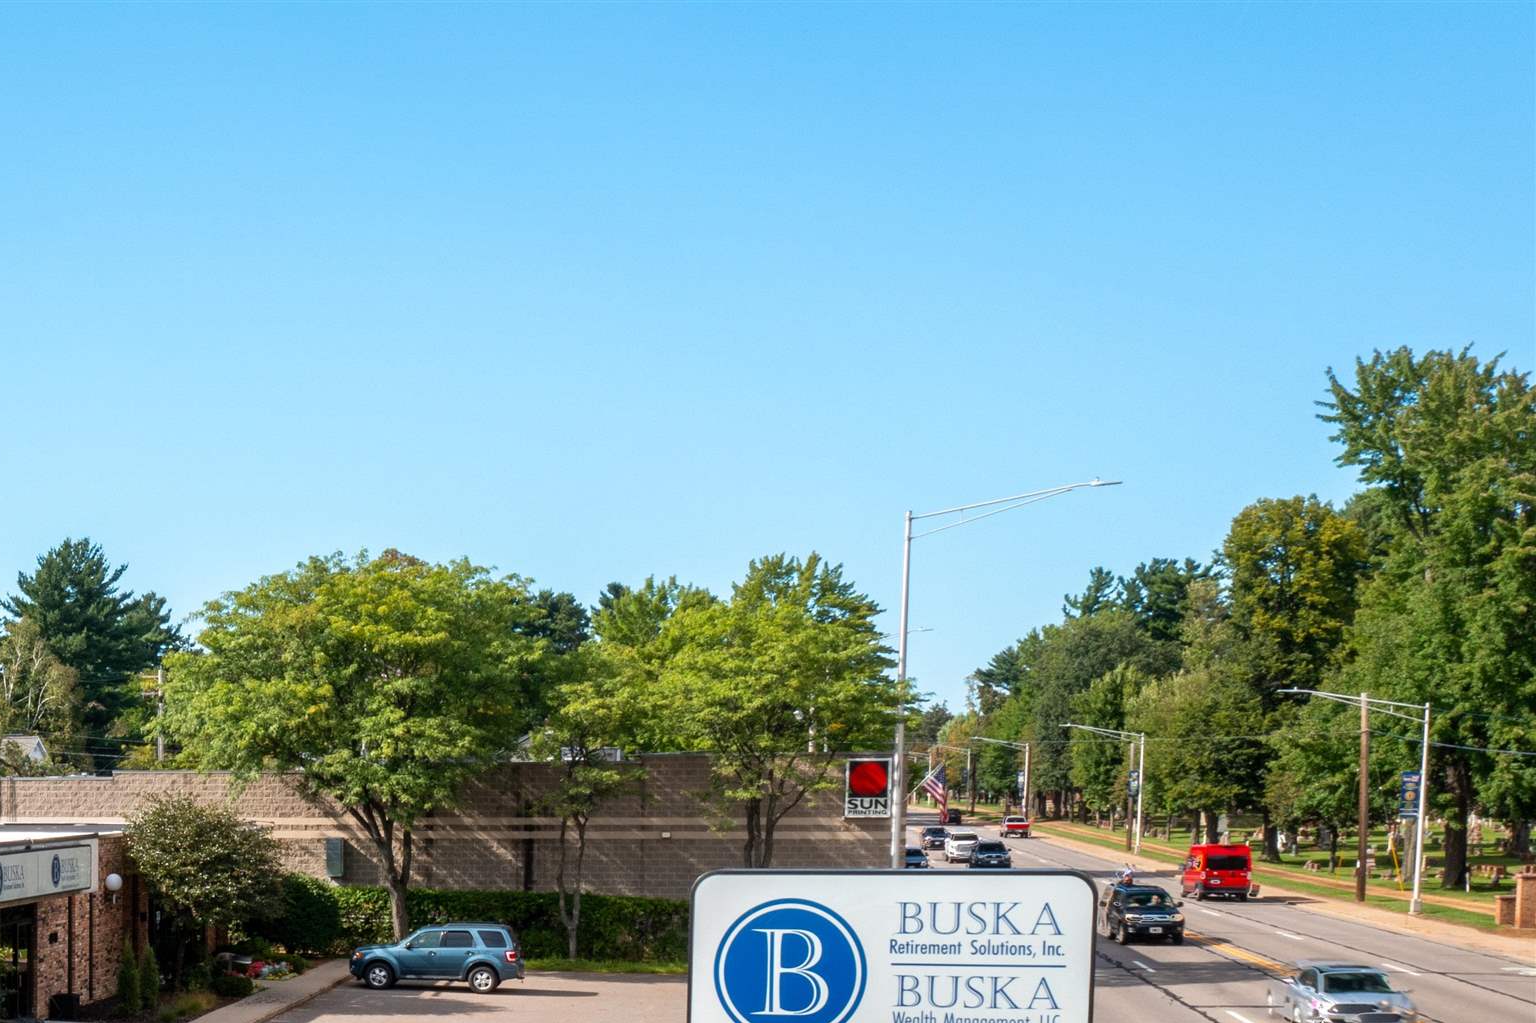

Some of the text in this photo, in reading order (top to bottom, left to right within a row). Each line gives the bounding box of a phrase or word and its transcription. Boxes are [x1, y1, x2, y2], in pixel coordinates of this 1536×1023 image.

[847, 798, 888, 809] SUN
[894, 901, 1064, 936] BUSKA
[889, 939, 1065, 958] Retirement Solutions, Inc.
[751, 928, 830, 1016] B
[892, 974, 1062, 1010] BUSKA
